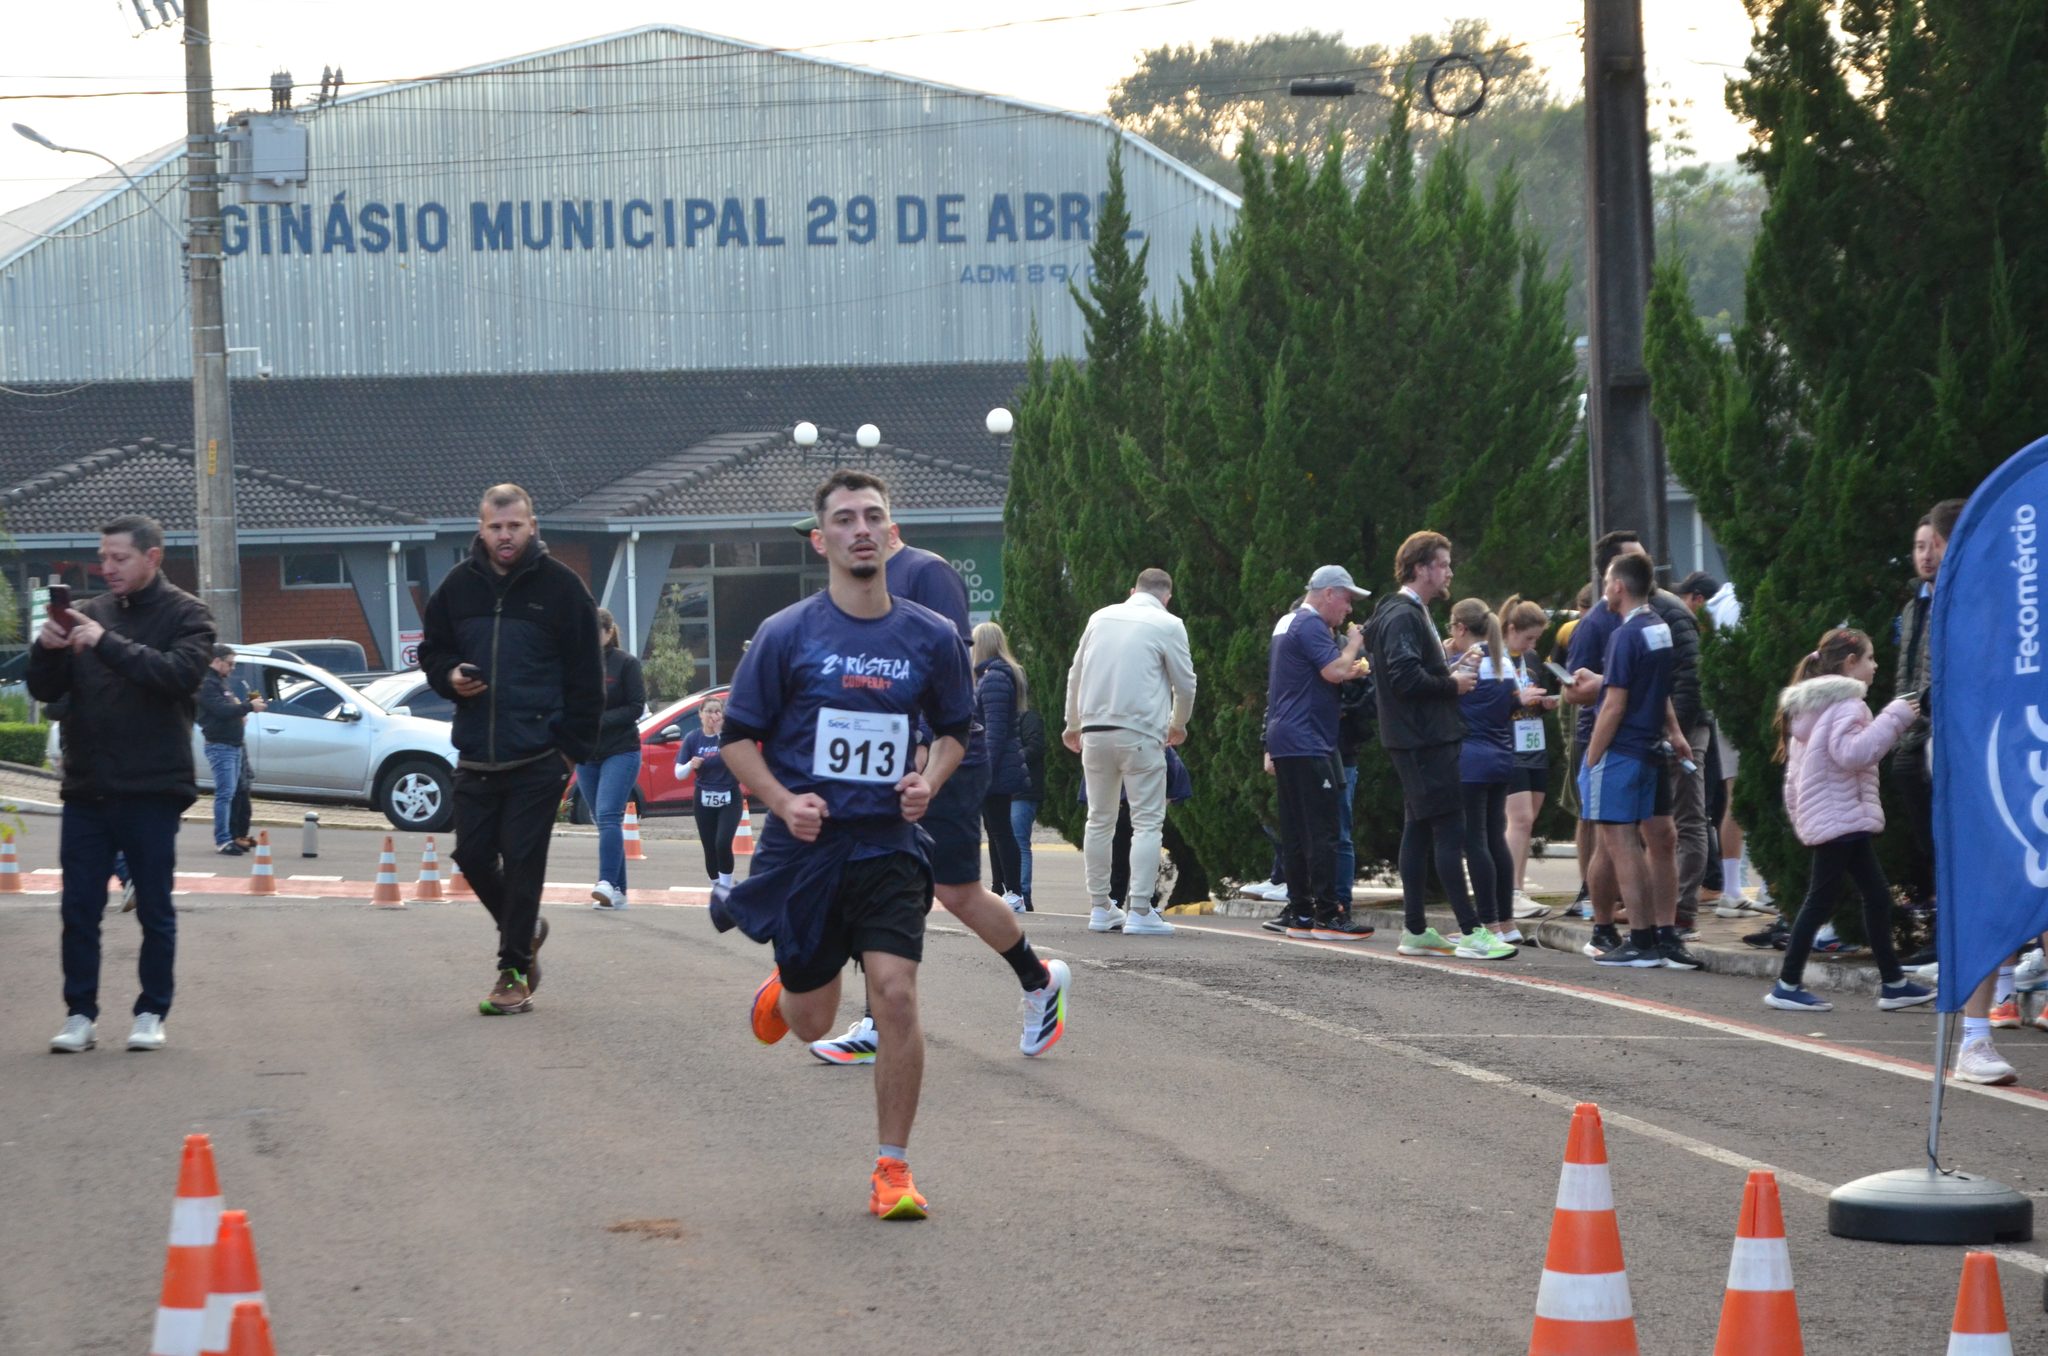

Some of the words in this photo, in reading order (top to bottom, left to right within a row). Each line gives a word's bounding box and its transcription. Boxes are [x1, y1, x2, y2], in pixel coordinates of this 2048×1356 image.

[220, 190, 449, 256] GINÁSIO
[470, 197, 785, 252] MUNICIPAL
[806, 194, 878, 245] 29
[896, 193, 967, 244] DE
[2010, 503, 2041, 676] Fecomércio
[828, 736, 896, 778] 913
[1525, 732, 1541, 749] 56
[705, 795, 727, 806] 754
